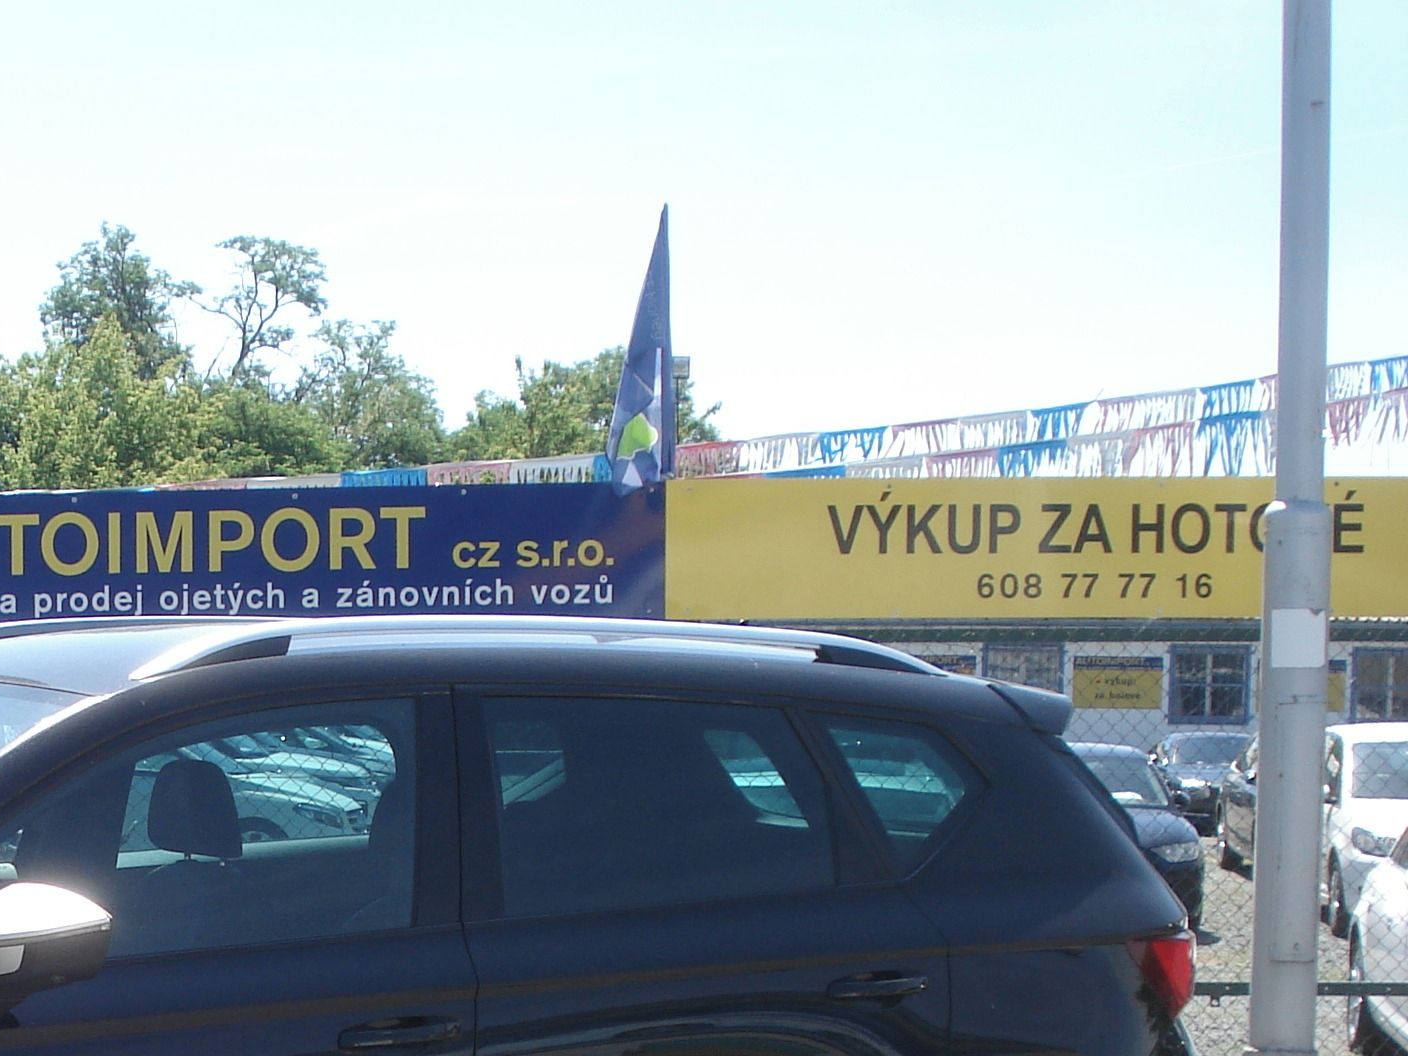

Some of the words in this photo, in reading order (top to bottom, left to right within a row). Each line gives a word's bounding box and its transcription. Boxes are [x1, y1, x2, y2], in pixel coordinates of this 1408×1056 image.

[827, 491, 1022, 555] VÝKUP
[1038, 503, 1113, 554] ZA
[1131, 490, 1365, 554] HOTÉ
[451, 540, 501, 569] cz
[515, 538, 616, 568] s.r.o.
[33, 584, 144, 618] prodej
[159, 581, 285, 616] ojetých
[300, 586, 320, 609] a
[335, 578, 515, 608] zánovních
[530, 574, 614, 606] vozů
[976, 572, 1043, 599] 608
[1060, 573, 1100, 598] 77
[1117, 573, 1157, 598] 77
[1174, 573, 1213, 598] 16
